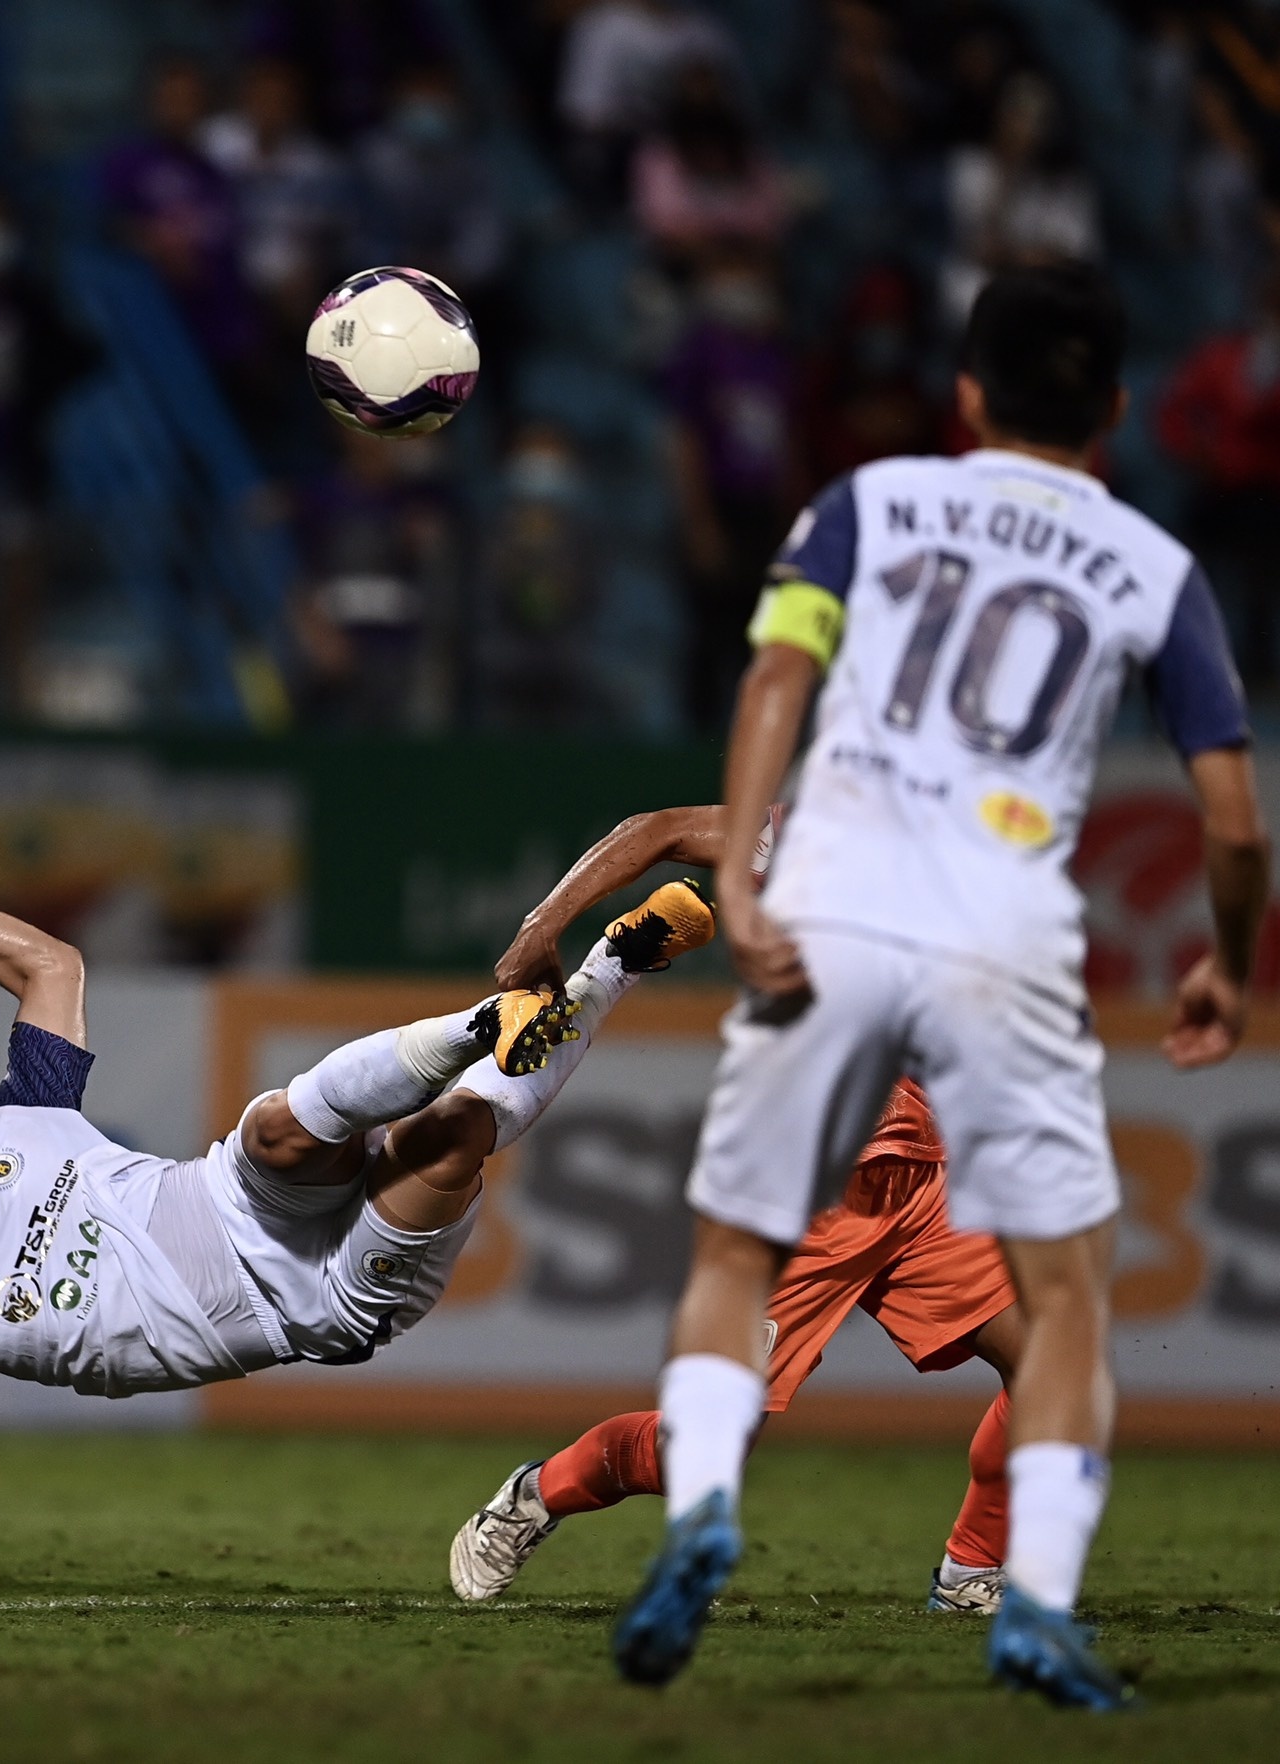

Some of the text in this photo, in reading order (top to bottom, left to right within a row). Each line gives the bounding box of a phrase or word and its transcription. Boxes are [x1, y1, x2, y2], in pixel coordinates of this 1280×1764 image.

[878, 549, 1092, 760] 10
[14, 1204, 51, 1270] T&T
[43, 1158, 75, 1213] GROUP
